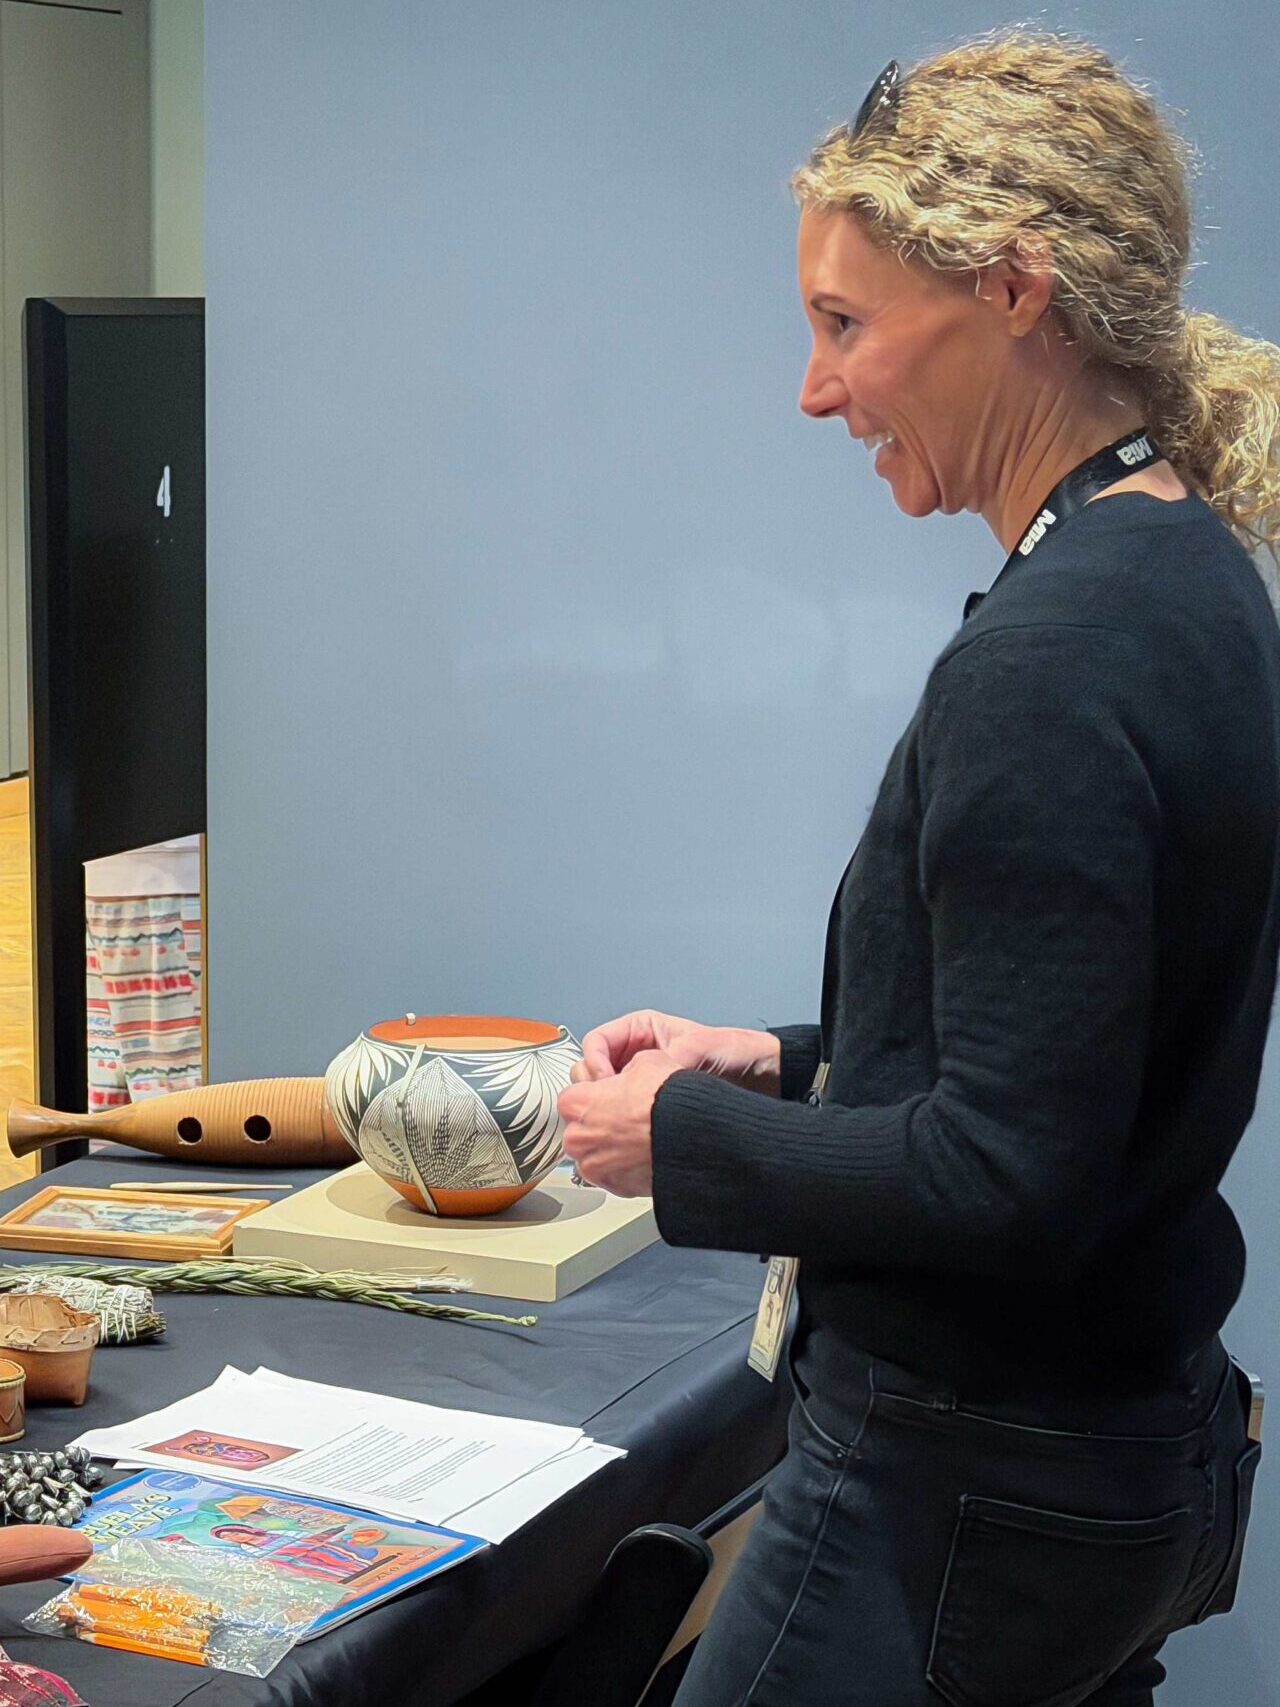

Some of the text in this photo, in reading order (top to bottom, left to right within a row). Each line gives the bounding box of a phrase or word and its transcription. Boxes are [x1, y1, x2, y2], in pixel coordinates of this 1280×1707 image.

[1116, 437, 1153, 466] Mia
[156, 465, 171, 517] 4
[81, 1493, 172, 1538] BUELA'S
